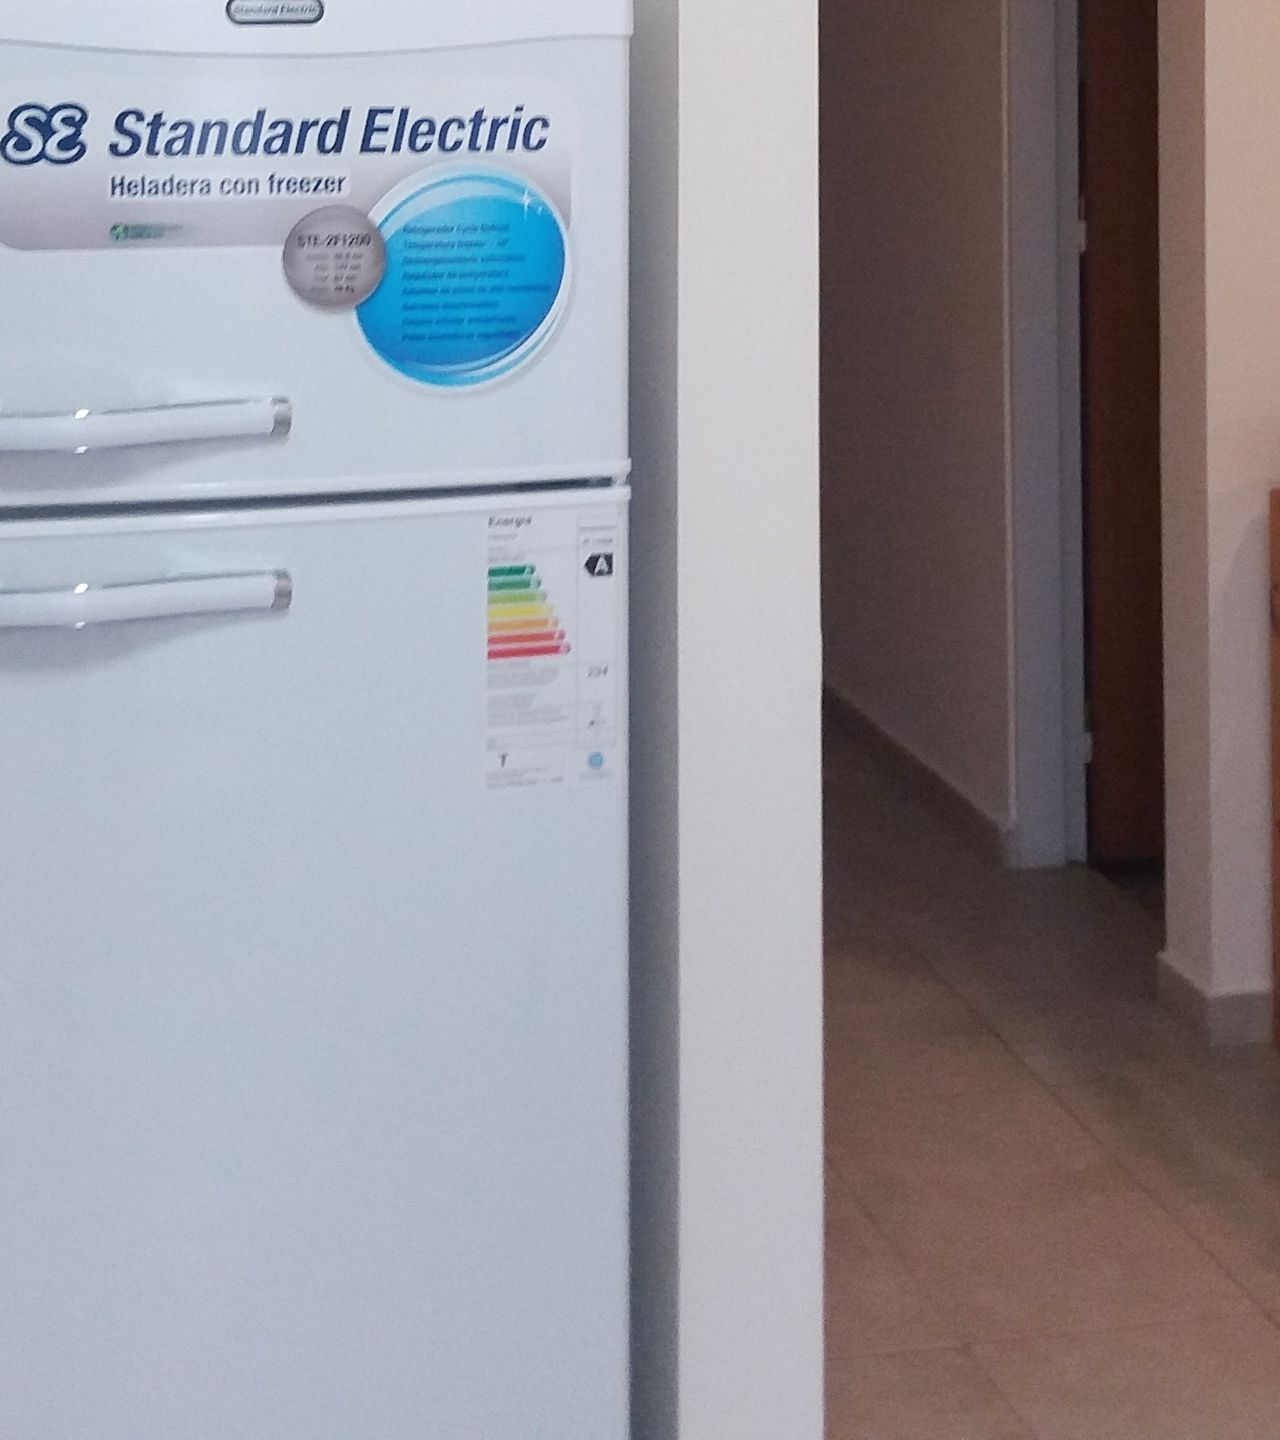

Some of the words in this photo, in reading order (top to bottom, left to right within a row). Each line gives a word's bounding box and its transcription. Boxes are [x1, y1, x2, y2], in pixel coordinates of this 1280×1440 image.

[109, 106, 352, 159] Standard
[359, 105, 550, 154] Electric
[110, 174, 212, 198] Heladera
[219, 177, 261, 196] con
[267, 172, 347, 196] freezer
